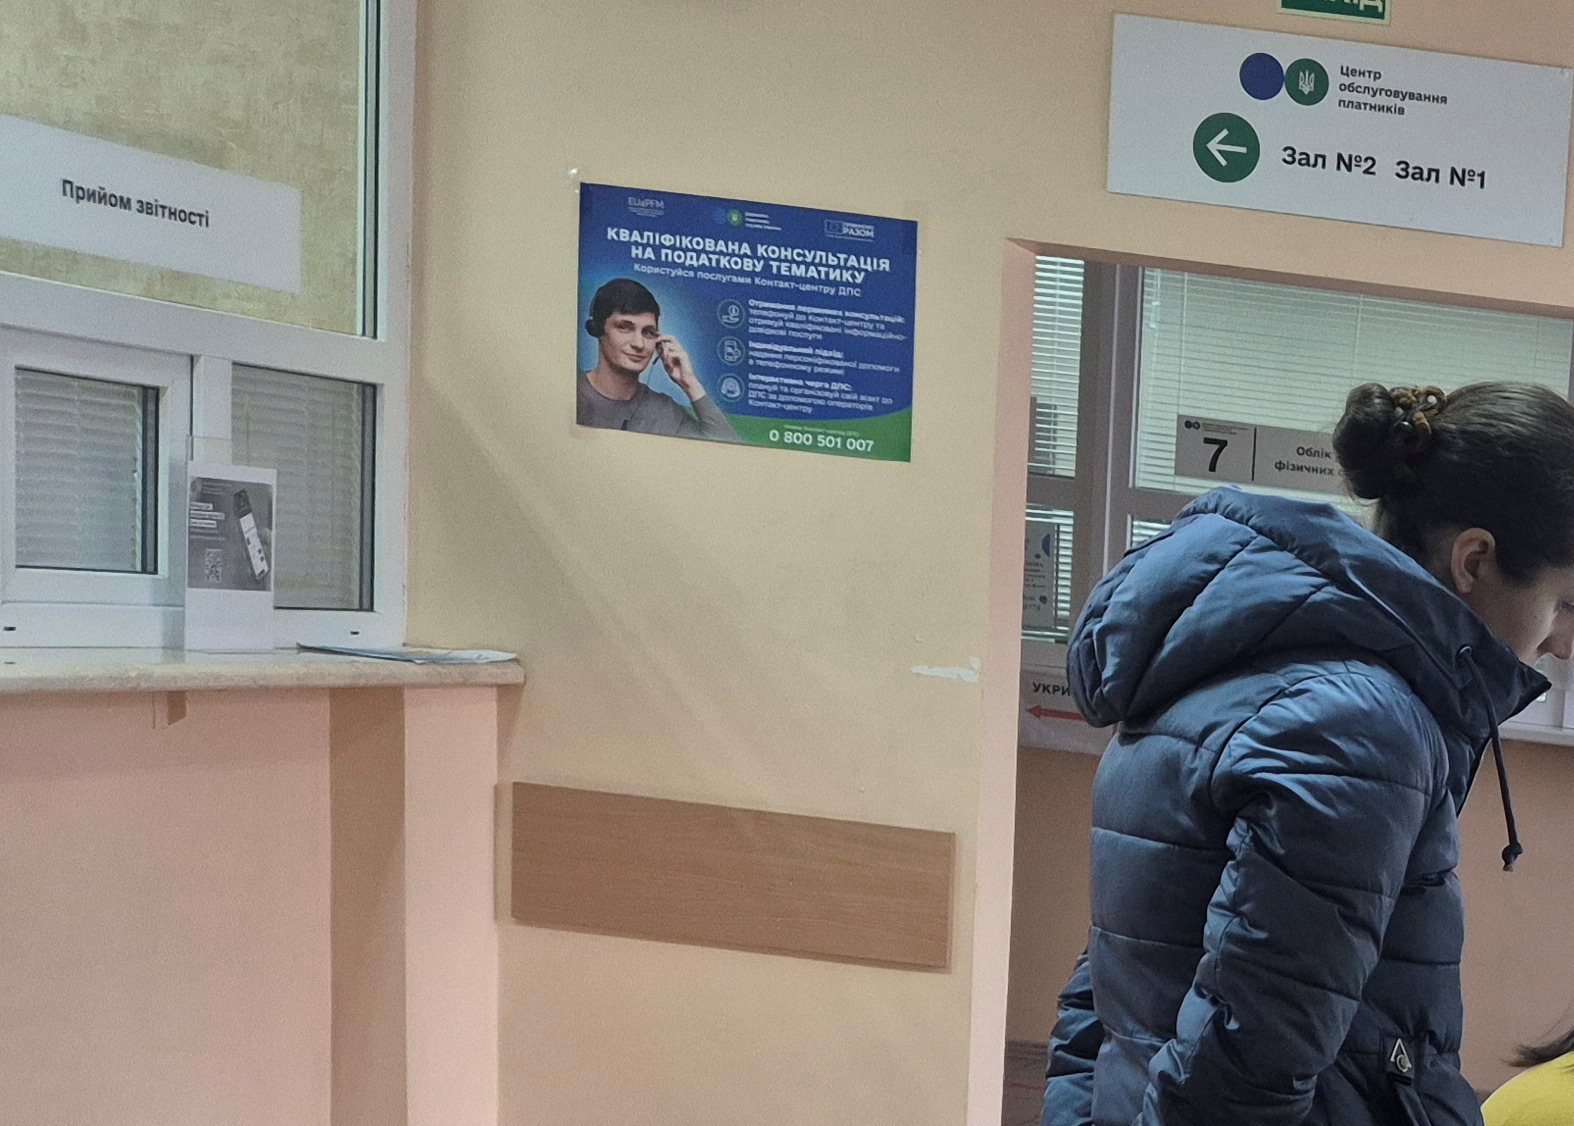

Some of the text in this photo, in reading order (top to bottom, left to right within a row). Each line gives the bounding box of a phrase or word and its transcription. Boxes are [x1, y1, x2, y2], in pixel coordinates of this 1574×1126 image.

[1340, 65, 1382, 81] Центр
[1339, 82, 1448, 105] обслуговування
[1338, 99, 1405, 115] платників
[1282, 146, 1377, 176] Зал №2
[1395, 160, 1486, 189] Зал №1
[62, 178, 209, 228] Прийом звітності
[843, 227, 874, 238] РАЗОМ
[607, 227, 891, 272] КВАЛІФІКОВАНА КОНСУЛЬТАЦІЯ
[631, 245, 866, 284] НА ПОДАТКОВУ ТЕМАТИКУ
[634, 263, 862, 298] Користуйся послугами Контакт-центру ДПС
[769, 429, 780, 442] 0
[783, 430, 813, 446] 800
[817, 434, 842, 449] 501
[846, 437, 875, 453] 007
[1296, 445, 1333, 460] Облік
[1202, 436, 1229, 473] 7
[1274, 459, 1336, 477] фізичних
